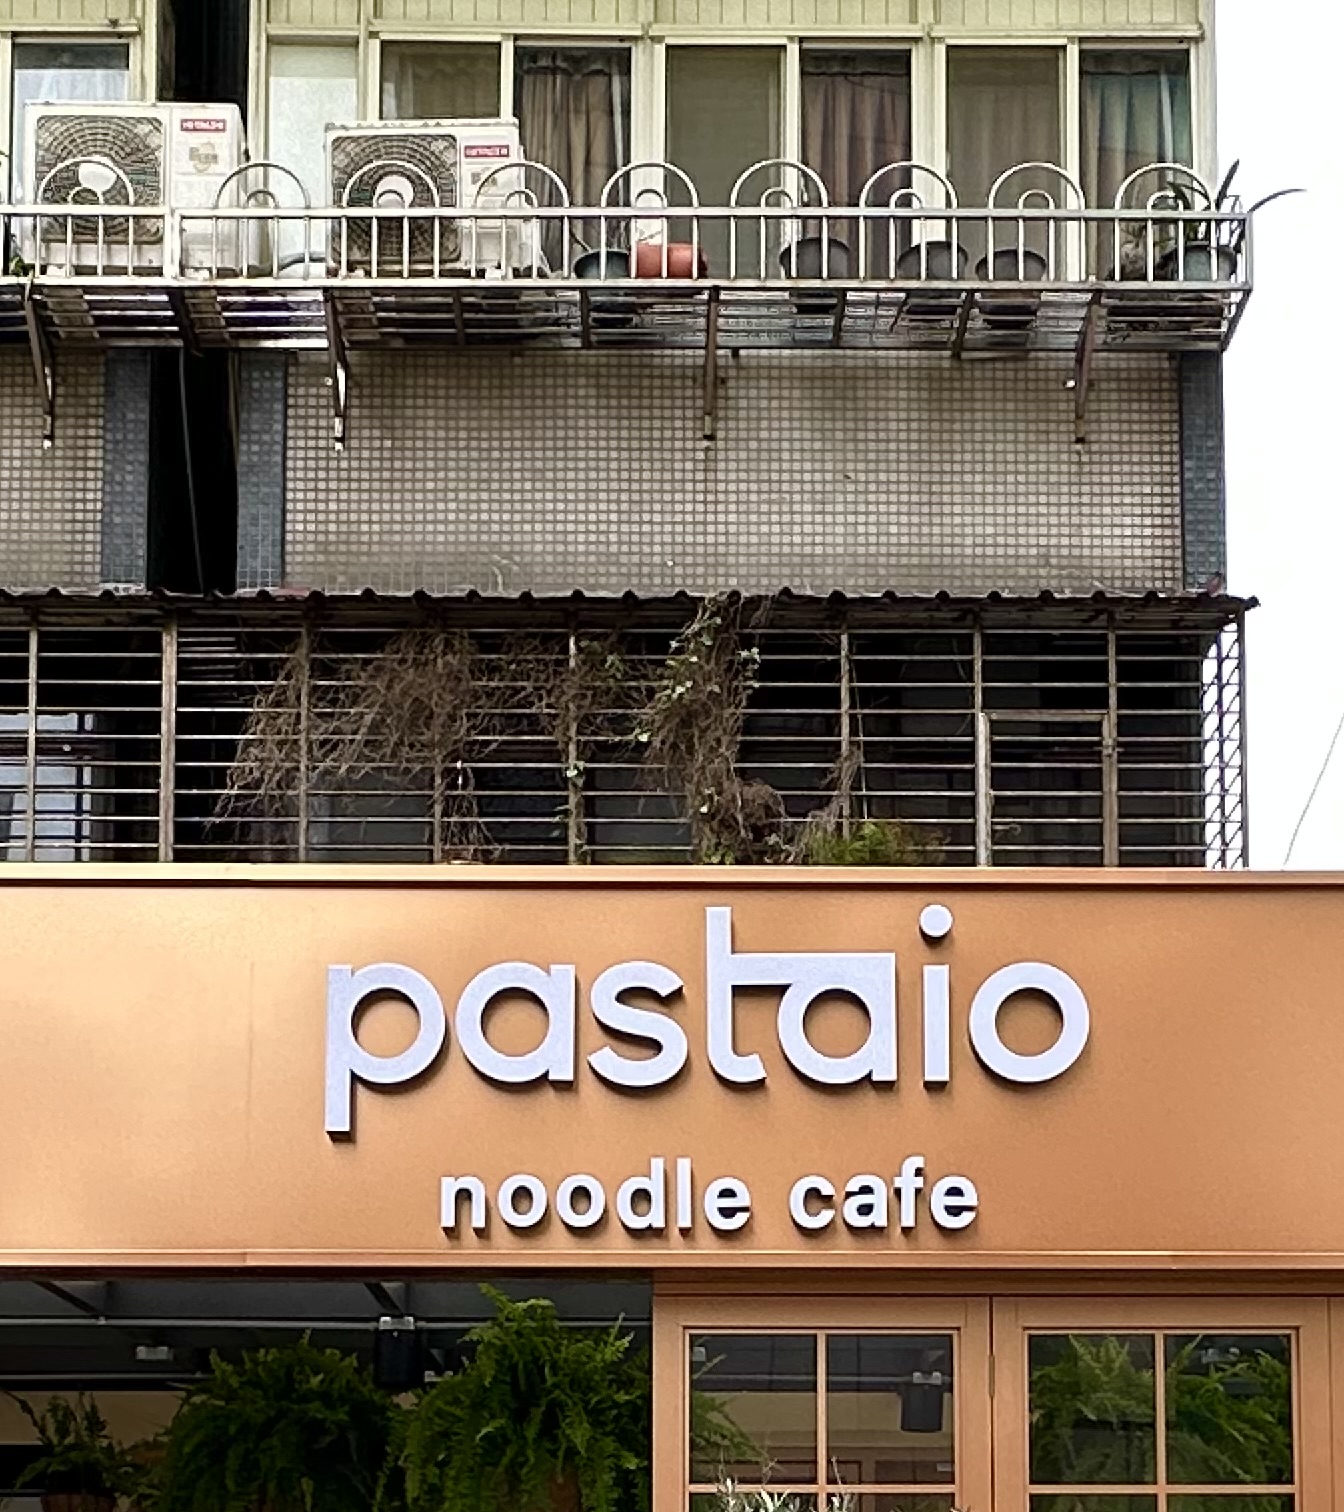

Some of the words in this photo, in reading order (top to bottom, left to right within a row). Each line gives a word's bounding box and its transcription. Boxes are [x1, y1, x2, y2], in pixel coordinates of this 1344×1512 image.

[325, 904, 1091, 1136] pastaio
[440, 1156, 751, 1232] noodle
[789, 1156, 980, 1231] cafe
